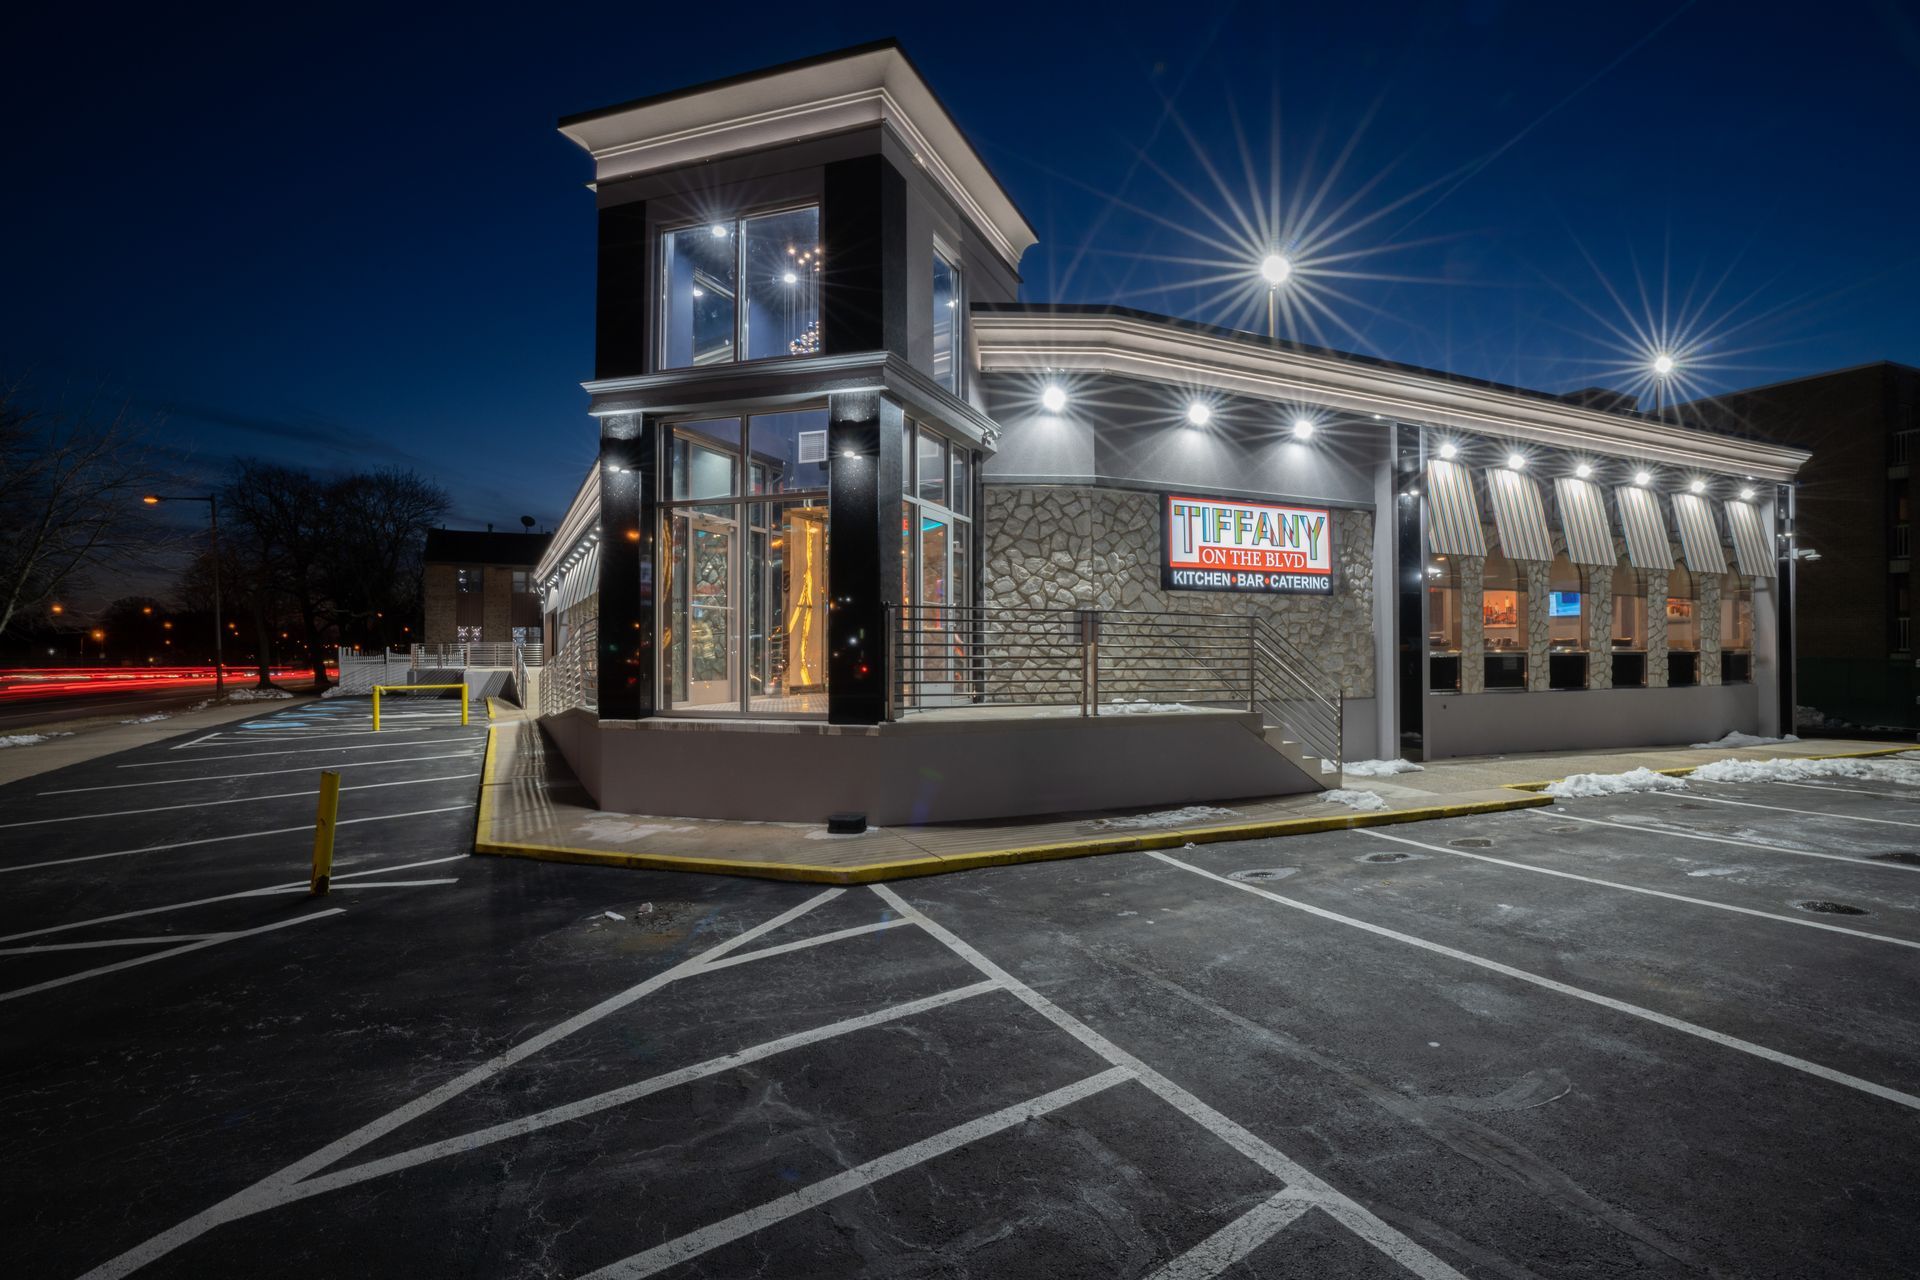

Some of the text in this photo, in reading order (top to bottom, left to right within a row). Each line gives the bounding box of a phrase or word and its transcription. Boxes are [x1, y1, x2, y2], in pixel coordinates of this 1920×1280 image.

[1174, 505, 1325, 560] TIFFANY
[1202, 548, 1304, 568] ON THE BLVD
[1174, 571, 1329, 589] KITCHEN BAR CATERING
